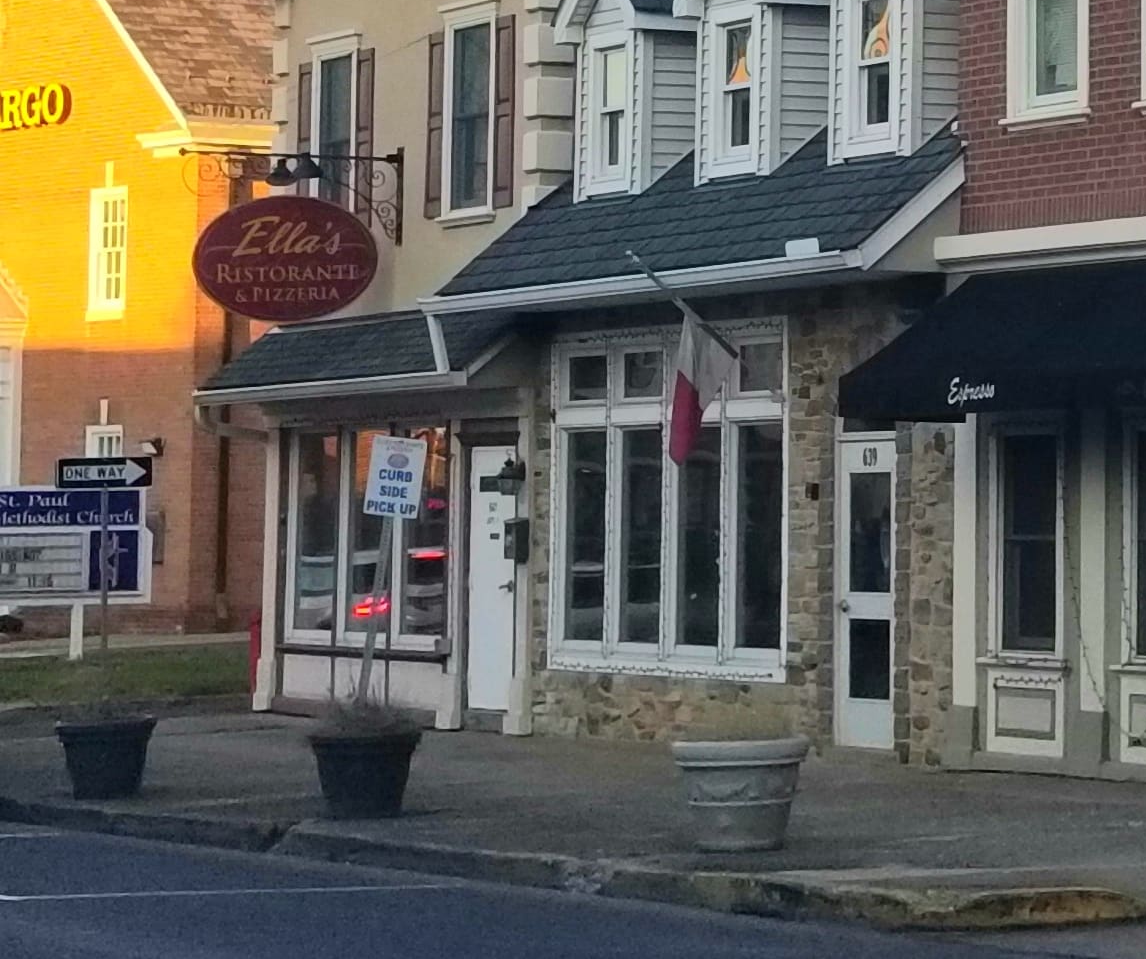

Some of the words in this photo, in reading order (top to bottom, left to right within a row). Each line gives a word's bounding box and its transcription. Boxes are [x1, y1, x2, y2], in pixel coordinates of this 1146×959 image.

[232, 215, 342, 257] Ella's
[216, 263, 360, 283] RISTORANTE
[235, 288, 248, 303] &
[252, 286, 340, 302] PIZZERIA
[947, 376, 995, 407] Espresso
[862, 447, 878, 467] 639
[65, 468, 89, 480] ONE
[97, 467, 126, 479] WAY
[379, 468, 413, 483] CURB
[29, 491, 71, 507] Paul
[379, 485, 408, 499] SIDE
[77, 508, 134, 525] Chrch
[366, 500, 396, 514] PICK
[399, 503, 417, 516] UP
